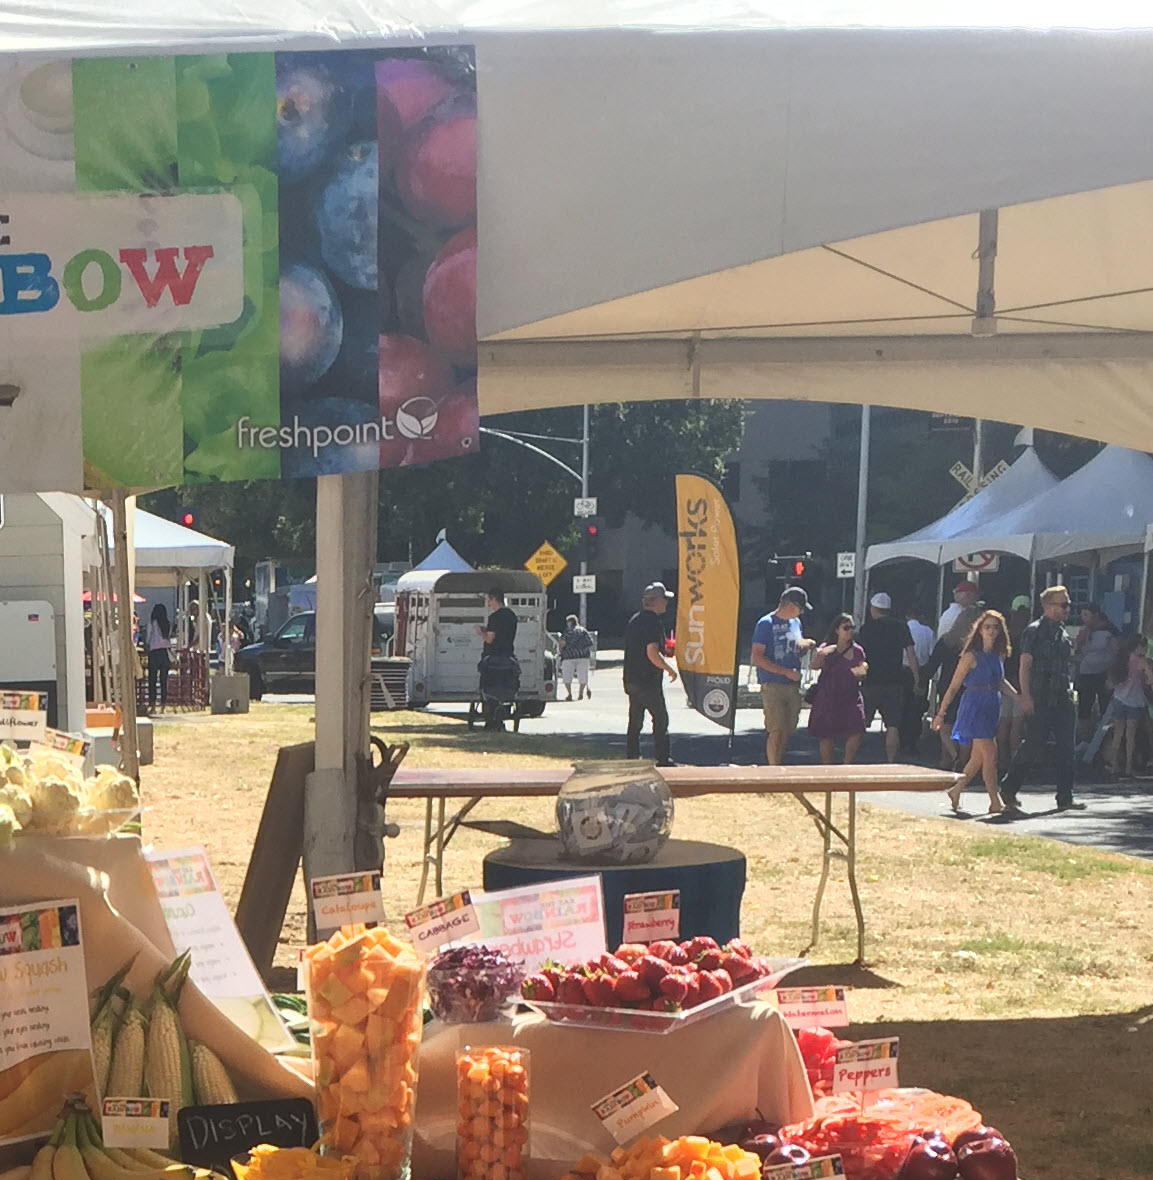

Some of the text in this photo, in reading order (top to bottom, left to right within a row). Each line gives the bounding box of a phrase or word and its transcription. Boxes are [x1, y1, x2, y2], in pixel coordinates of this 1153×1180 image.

[237, 415, 394, 458] freshpoint
[679, 498, 709, 667] sunworks
[418, 913, 470, 941] CABBAGE
[627, 918, 675, 931] Strawberry
[15, 956, 68, 985] Squash
[838, 1066, 891, 1086] Peppers
[187, 1113, 307, 1150] DISPLAY
